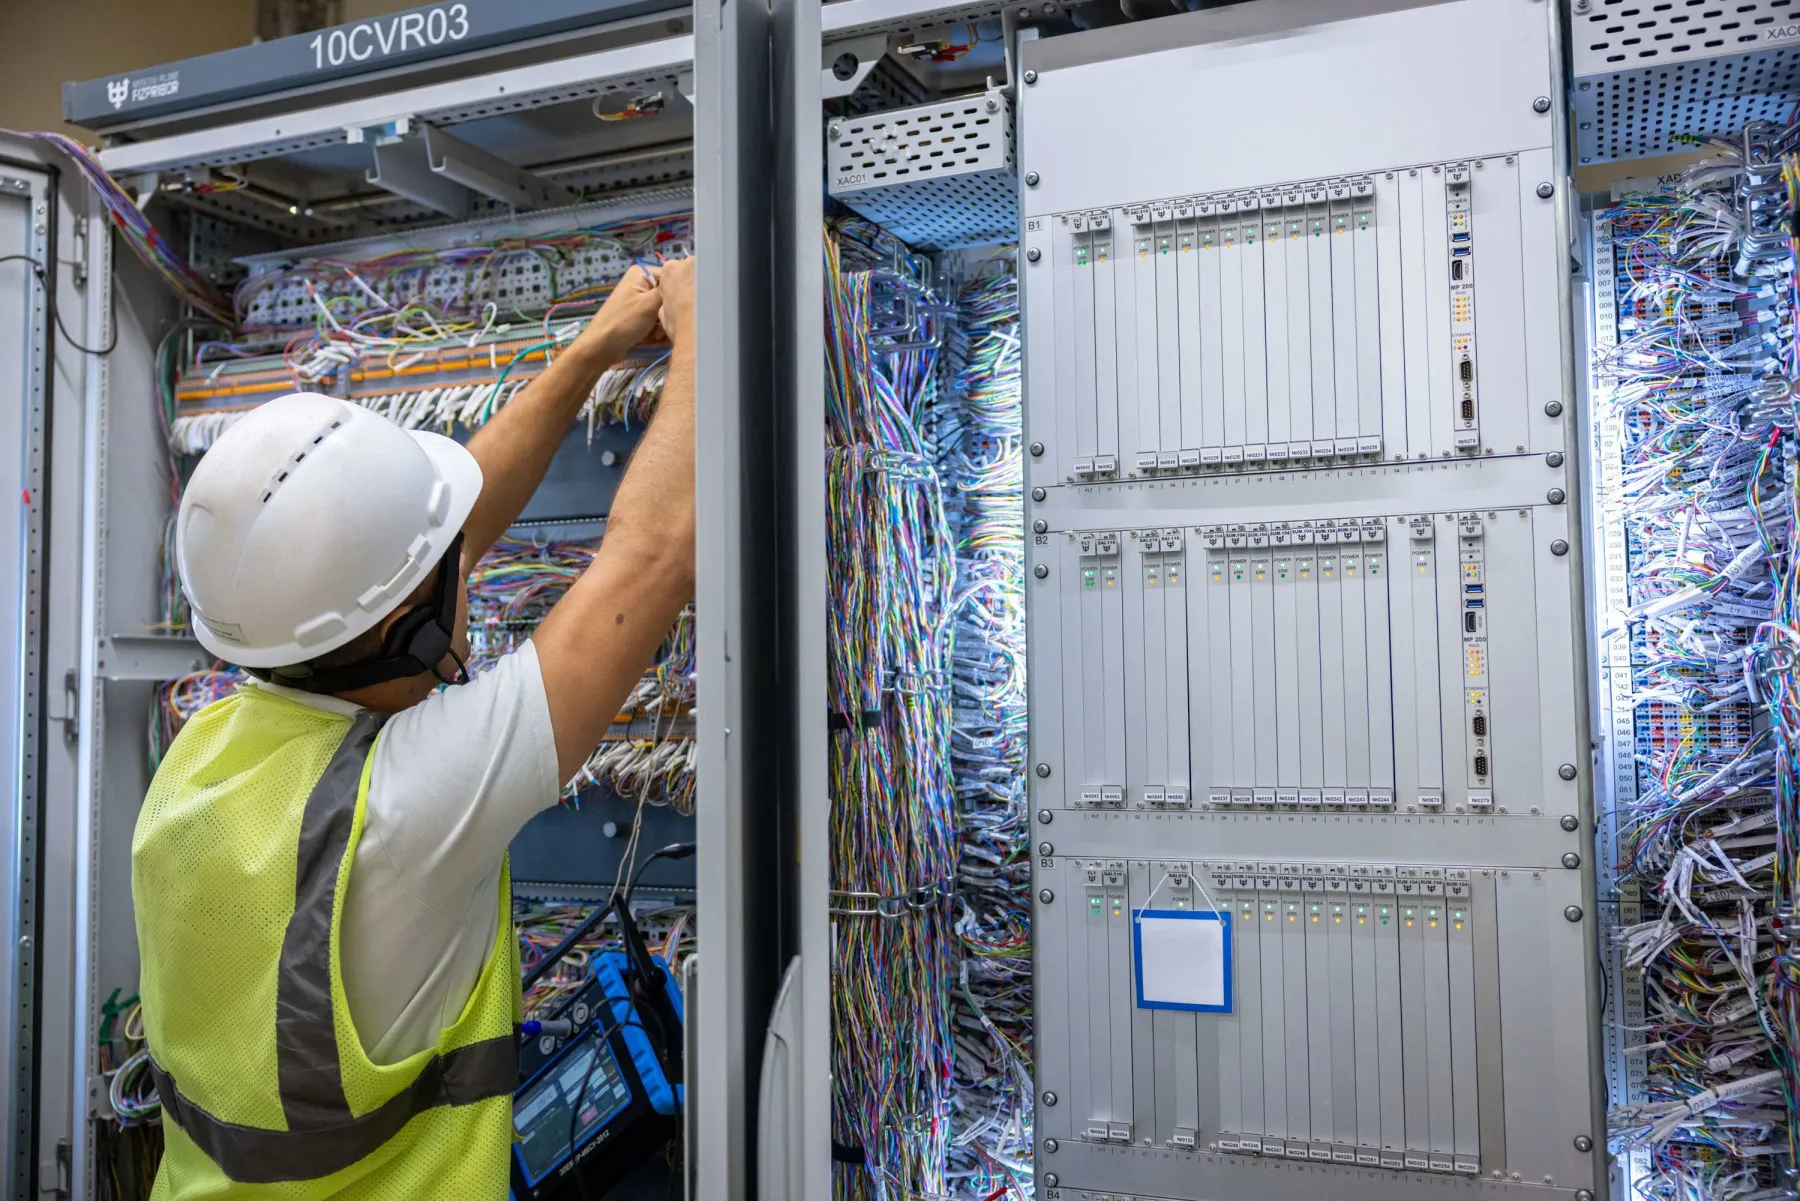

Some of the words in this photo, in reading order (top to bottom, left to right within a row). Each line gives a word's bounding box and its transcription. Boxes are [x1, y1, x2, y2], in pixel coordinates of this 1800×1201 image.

[309, 3, 469, 69] 10CVR03
[836, 174, 867, 186] XAC01
[1028, 220, 1041, 230] B1
[1035, 536, 1049, 546] B2
[1041, 859, 1054, 868] B3
[1047, 1190, 1060, 1199] B4
